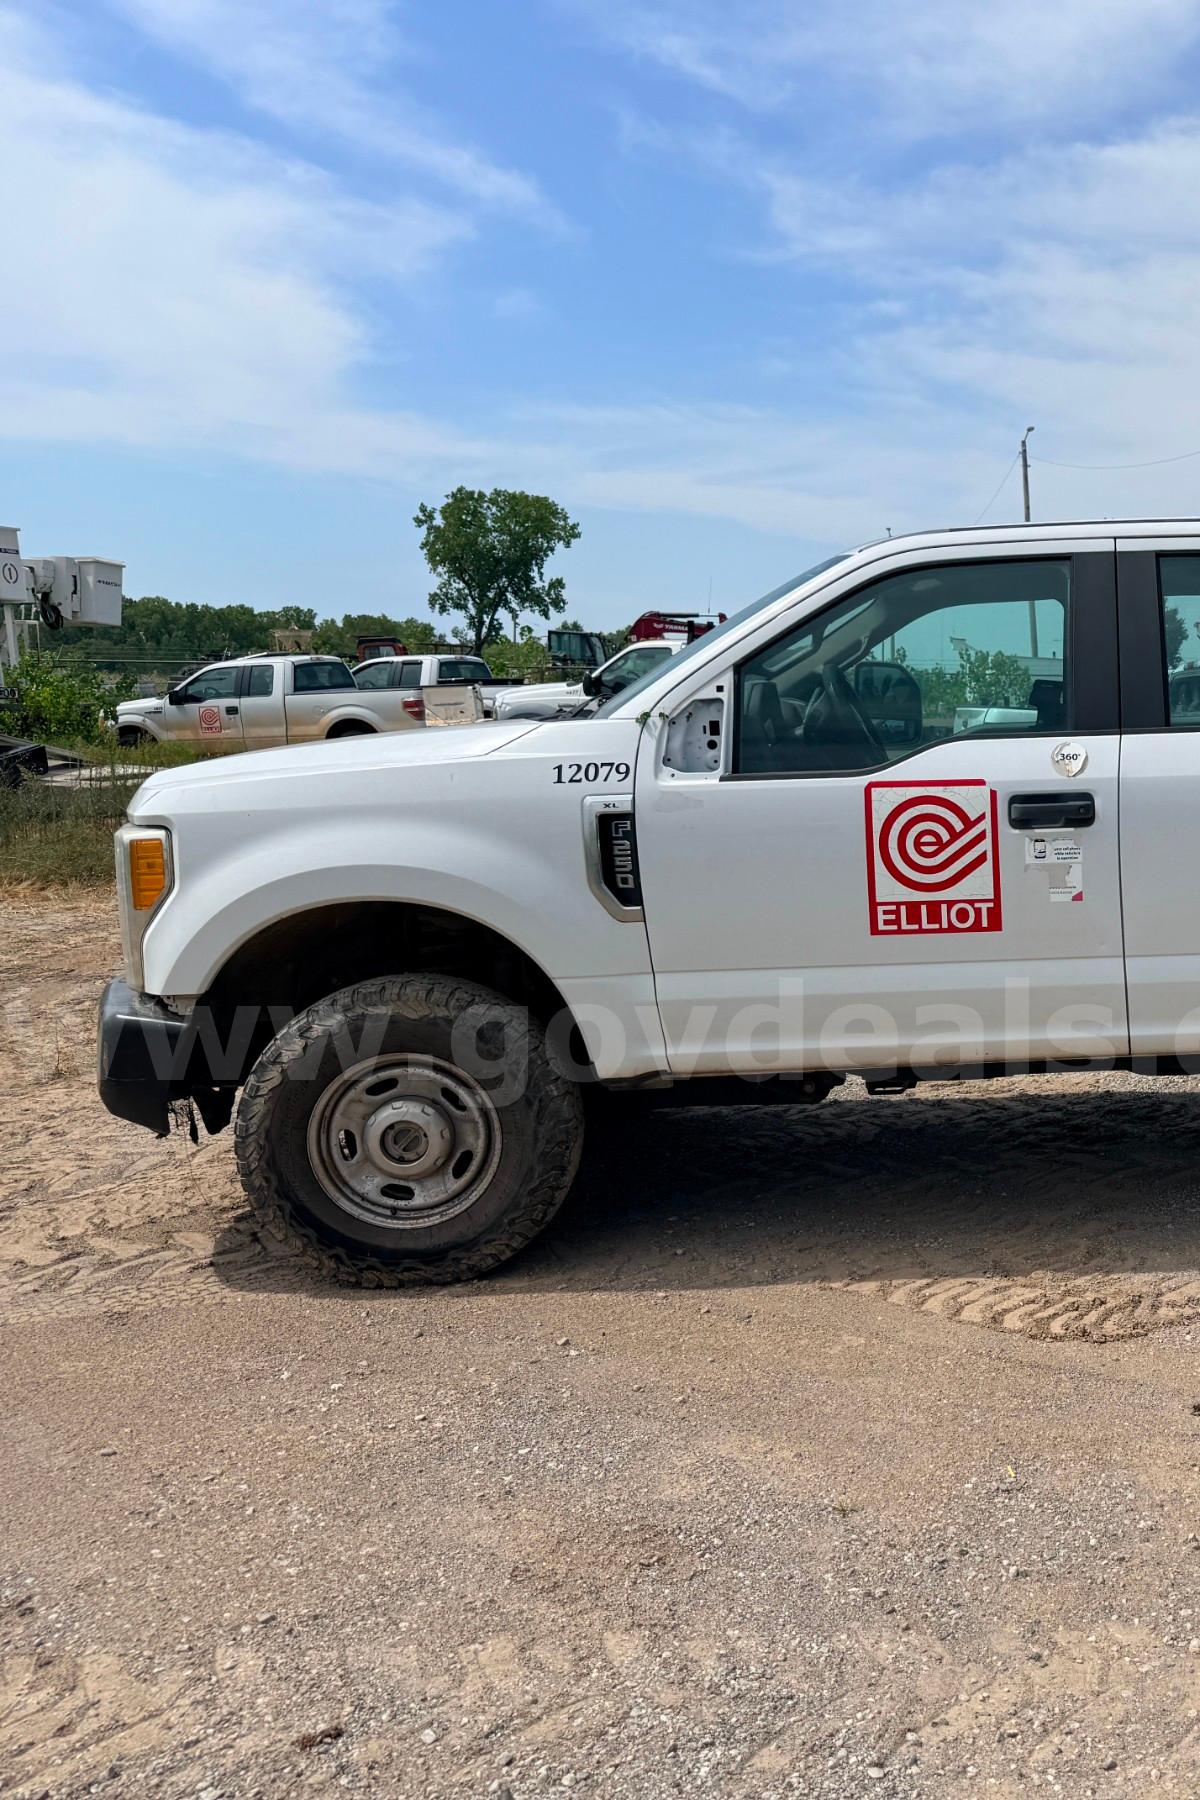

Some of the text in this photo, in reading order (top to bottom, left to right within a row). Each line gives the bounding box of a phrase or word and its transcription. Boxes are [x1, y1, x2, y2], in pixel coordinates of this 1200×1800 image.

[552, 762, 631, 785] 12079
[611, 820, 635, 889] F250
[877, 902, 994, 931] ELLIOT
